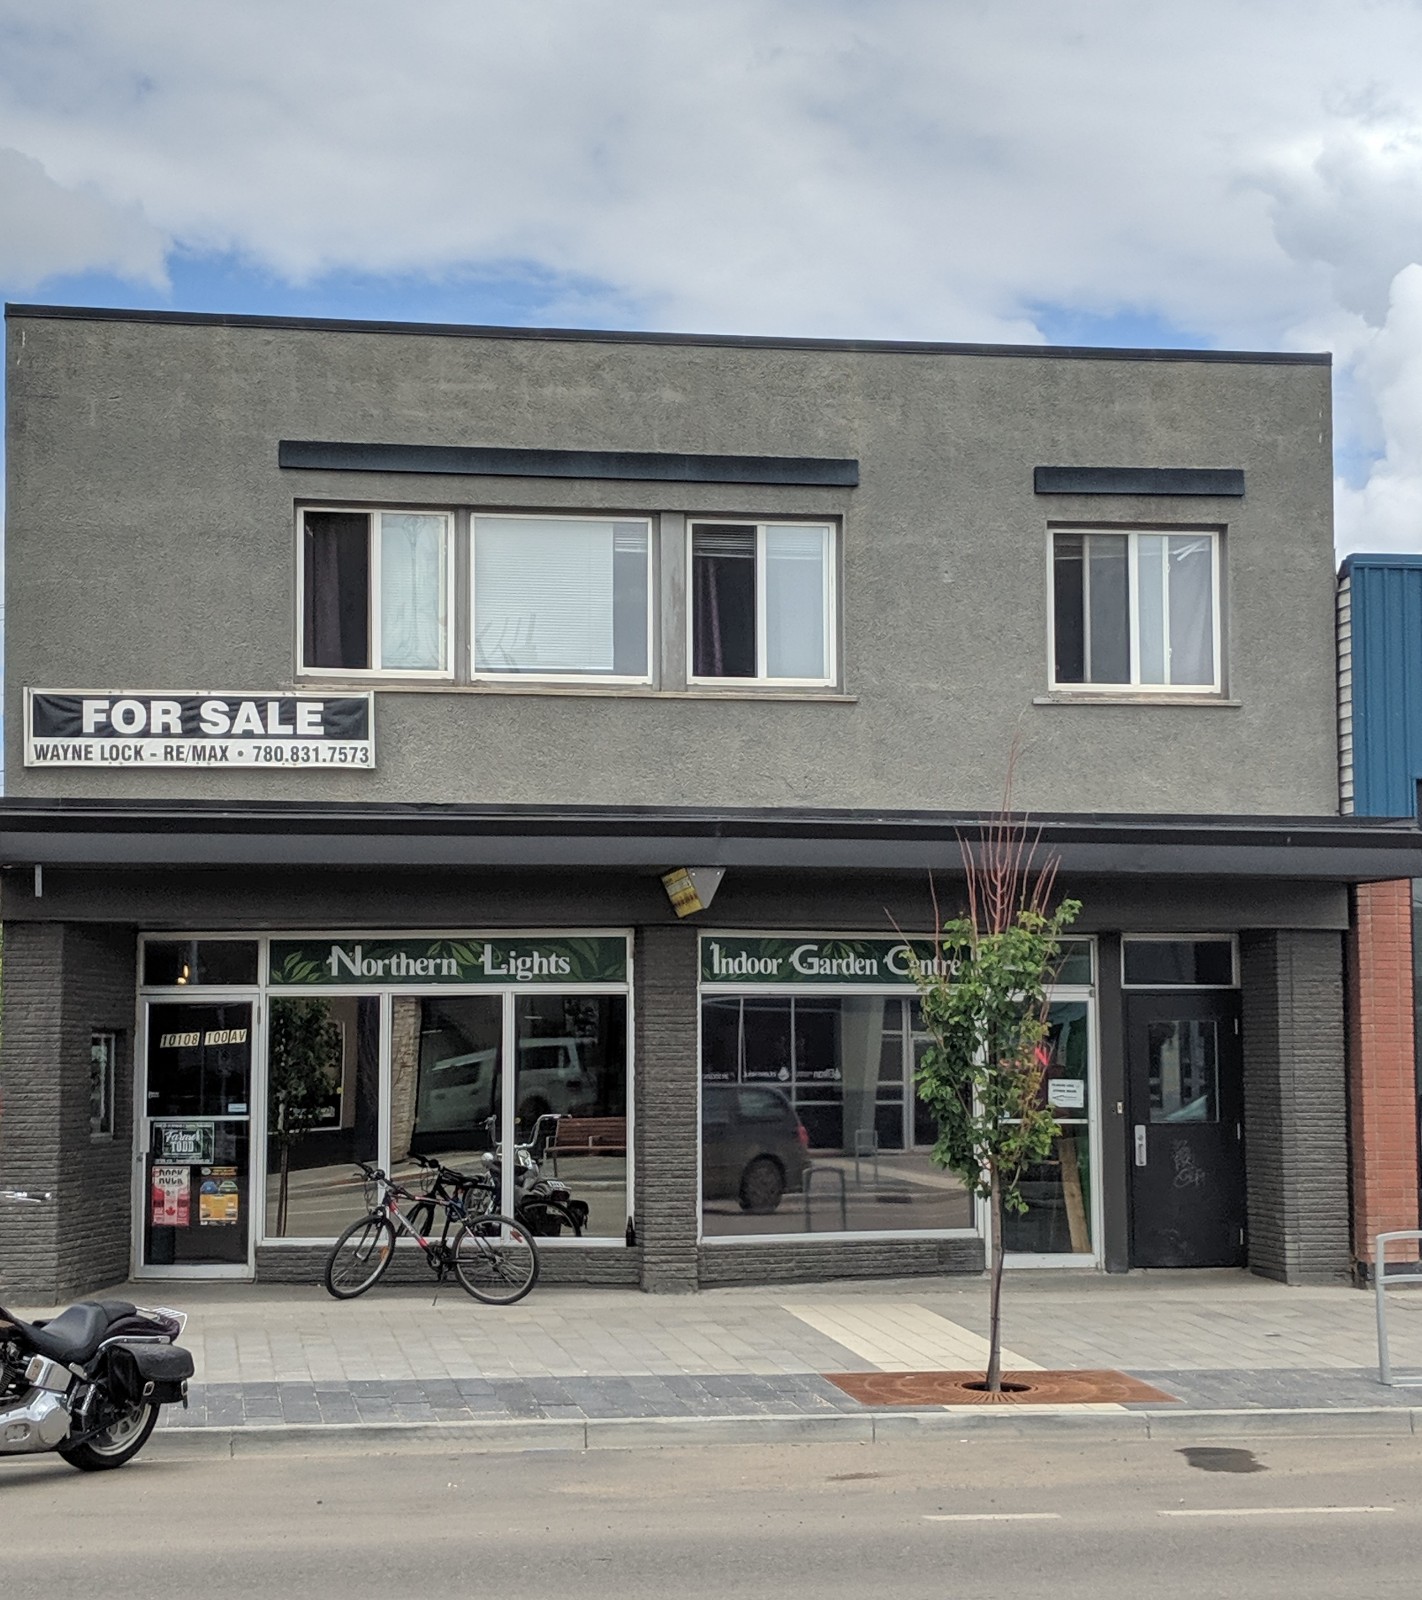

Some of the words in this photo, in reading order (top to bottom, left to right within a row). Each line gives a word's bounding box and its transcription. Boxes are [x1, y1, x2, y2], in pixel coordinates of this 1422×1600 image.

[82, 700, 183, 735] FOR
[199, 701, 325, 735] SALE
[33, 744, 94, 761] WAYNE
[100, 745, 145, 761] LOCK
[163, 744, 229, 763] RE/MAX
[252, 745, 369, 763] 780.831.7573
[326, 945, 458, 977] Northern
[478, 944, 571, 980] Lights
[709, 941, 782, 975] Indoor
[789, 944, 878, 975] Garden
[162, 1033, 198, 1046] 10108
[171, 1141, 194, 1152] TODD
